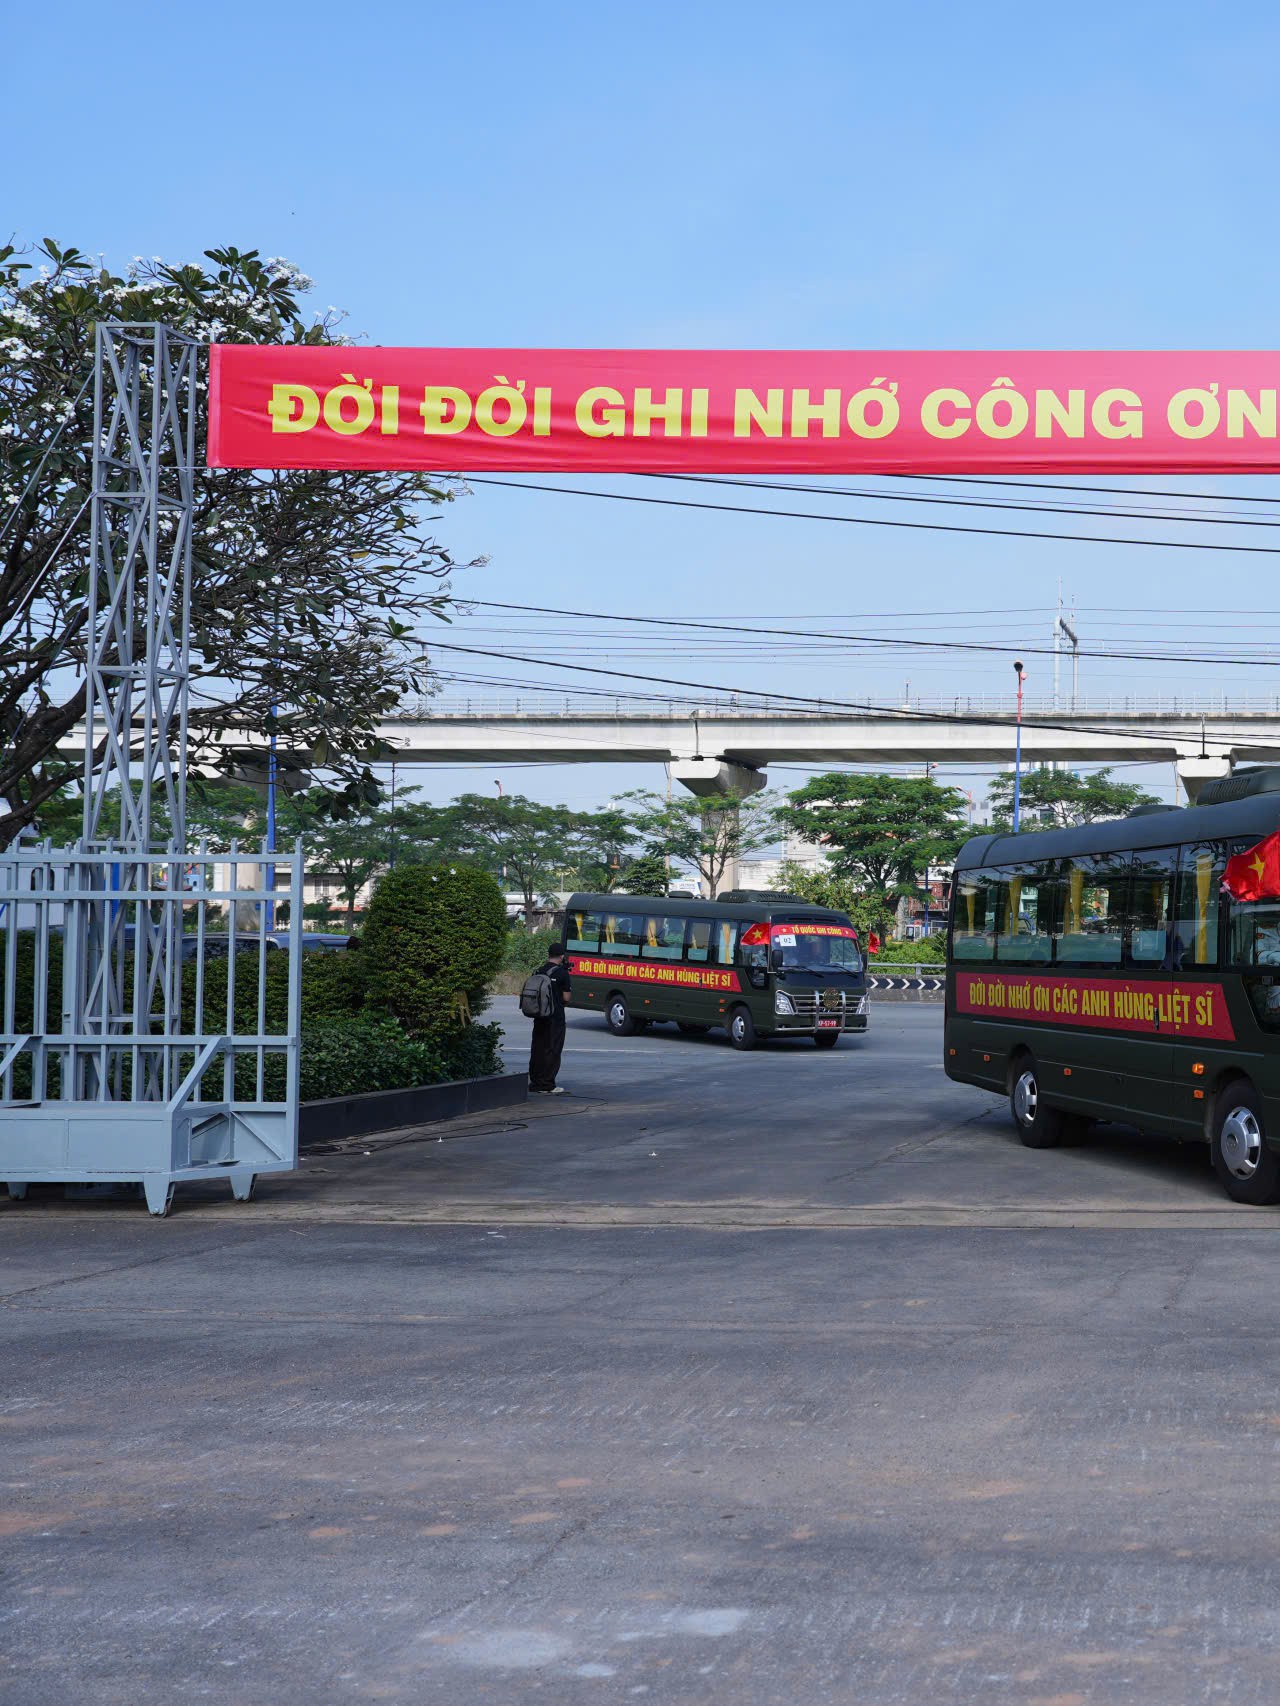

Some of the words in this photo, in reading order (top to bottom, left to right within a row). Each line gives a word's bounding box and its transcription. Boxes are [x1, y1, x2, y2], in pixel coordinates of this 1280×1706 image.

[268, 374, 398, 435] ĐỜI
[420, 376, 551, 436] ĐỜI
[576, 387, 708, 438] GHI
[735, 378, 899, 439] NHỚ
[922, 379, 1142, 439] CÔNG
[1169, 384, 1276, 439] ƠN
[579, 960, 592, 973] ĐỜI
[594, 962, 607, 974] ĐỜI
[608, 964, 625, 976] NHỚ
[626, 966, 637, 977] ƠN
[639, 966, 655, 979] CÁC
[657, 969, 675, 981] ANH
[677, 970, 700, 984] HÙNG
[701, 972, 721, 987] LIỆT
[721, 974, 731, 987] SĨ
[969, 978, 986, 1005] ĐỜI
[988, 979, 1006, 1008] ĐỜI
[1008, 981, 1031, 1010] NHỚ
[1033, 984, 1050, 1012] ƠN
[1053, 984, 1078, 1015] CÁC
[1081, 989, 1110, 1017] ANH
[1113, 986, 1154, 1021] HÙNG
[1158, 989, 1190, 1030] LIỆT
[1195, 991, 1213, 1026] SĨ
